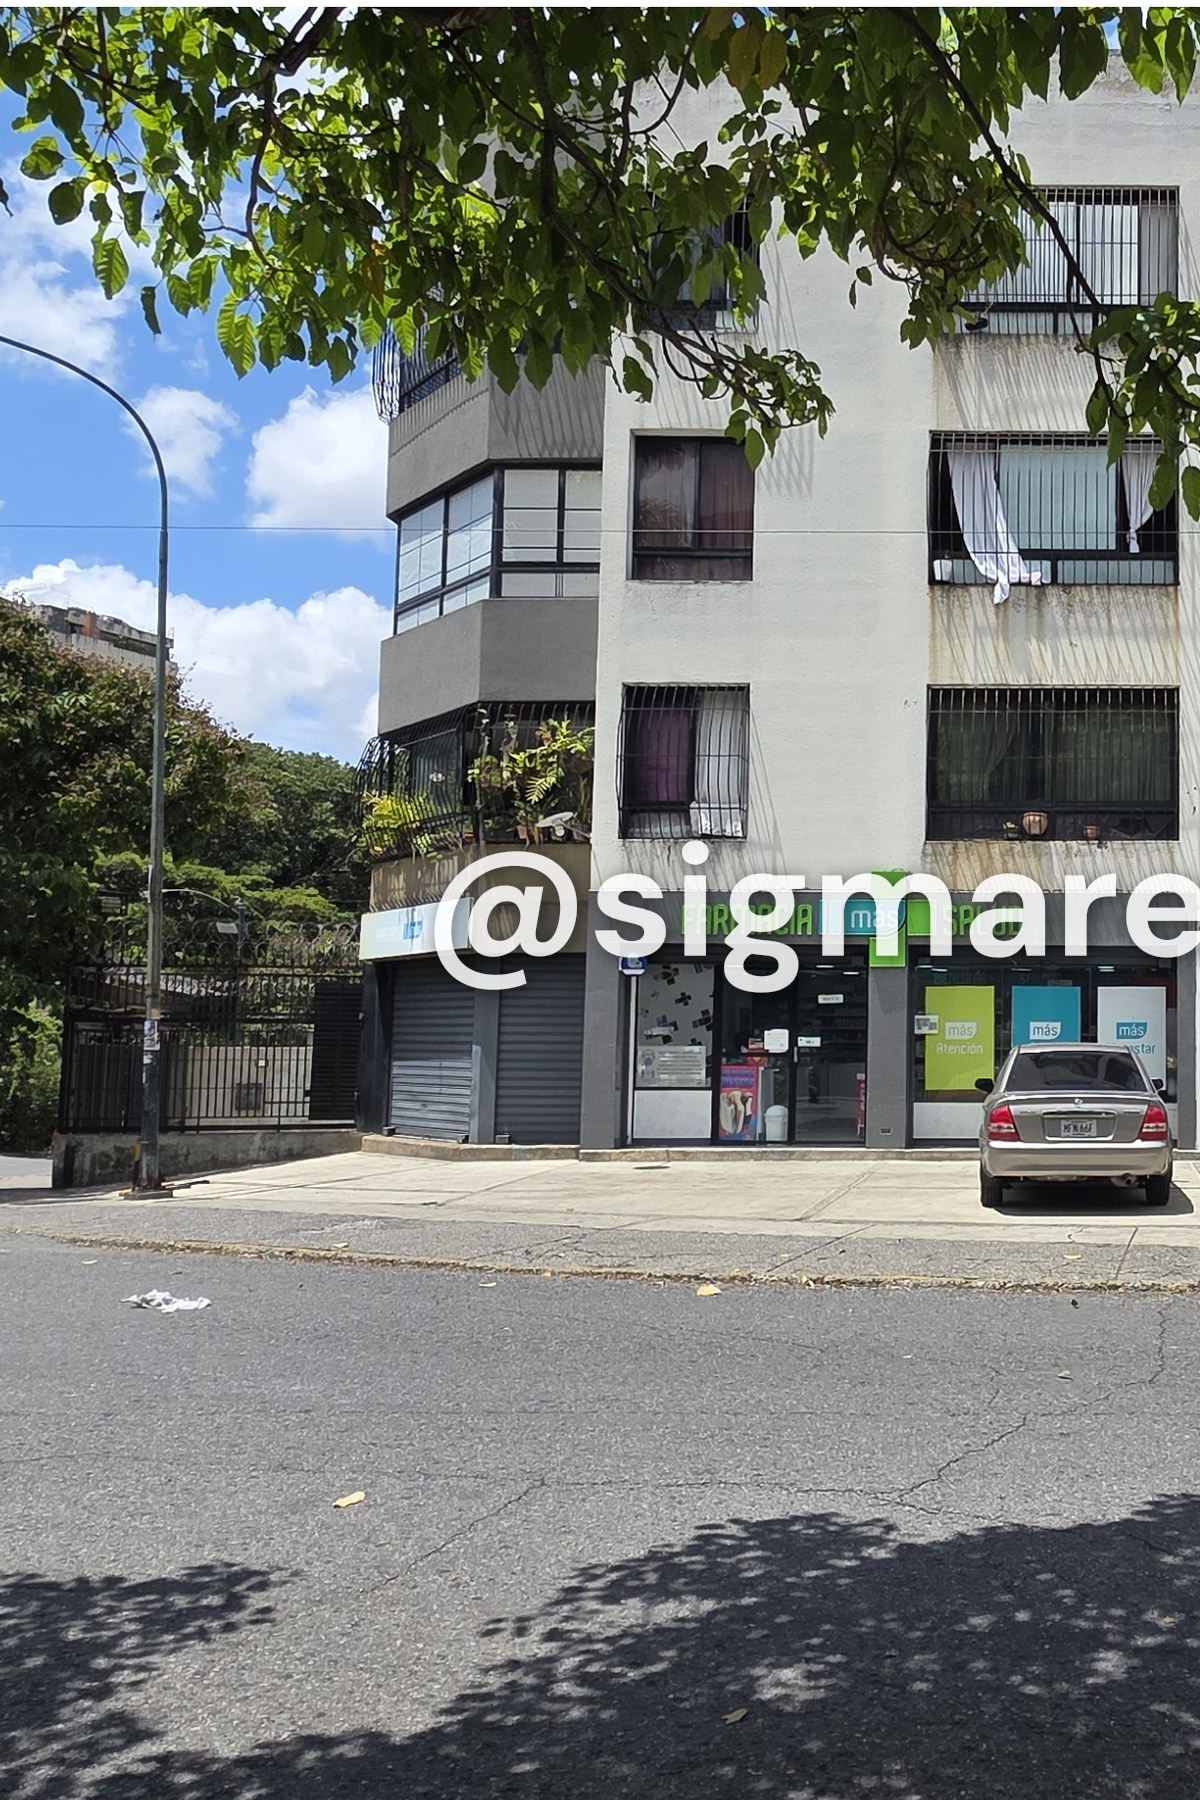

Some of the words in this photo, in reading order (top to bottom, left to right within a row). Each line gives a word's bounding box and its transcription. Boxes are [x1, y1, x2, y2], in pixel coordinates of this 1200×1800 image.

[948, 1024, 974, 1036] más
[1032, 1023, 1059, 1036] más
[1119, 1023, 1145, 1036] más
[936, 1042, 983, 1054] Atención
